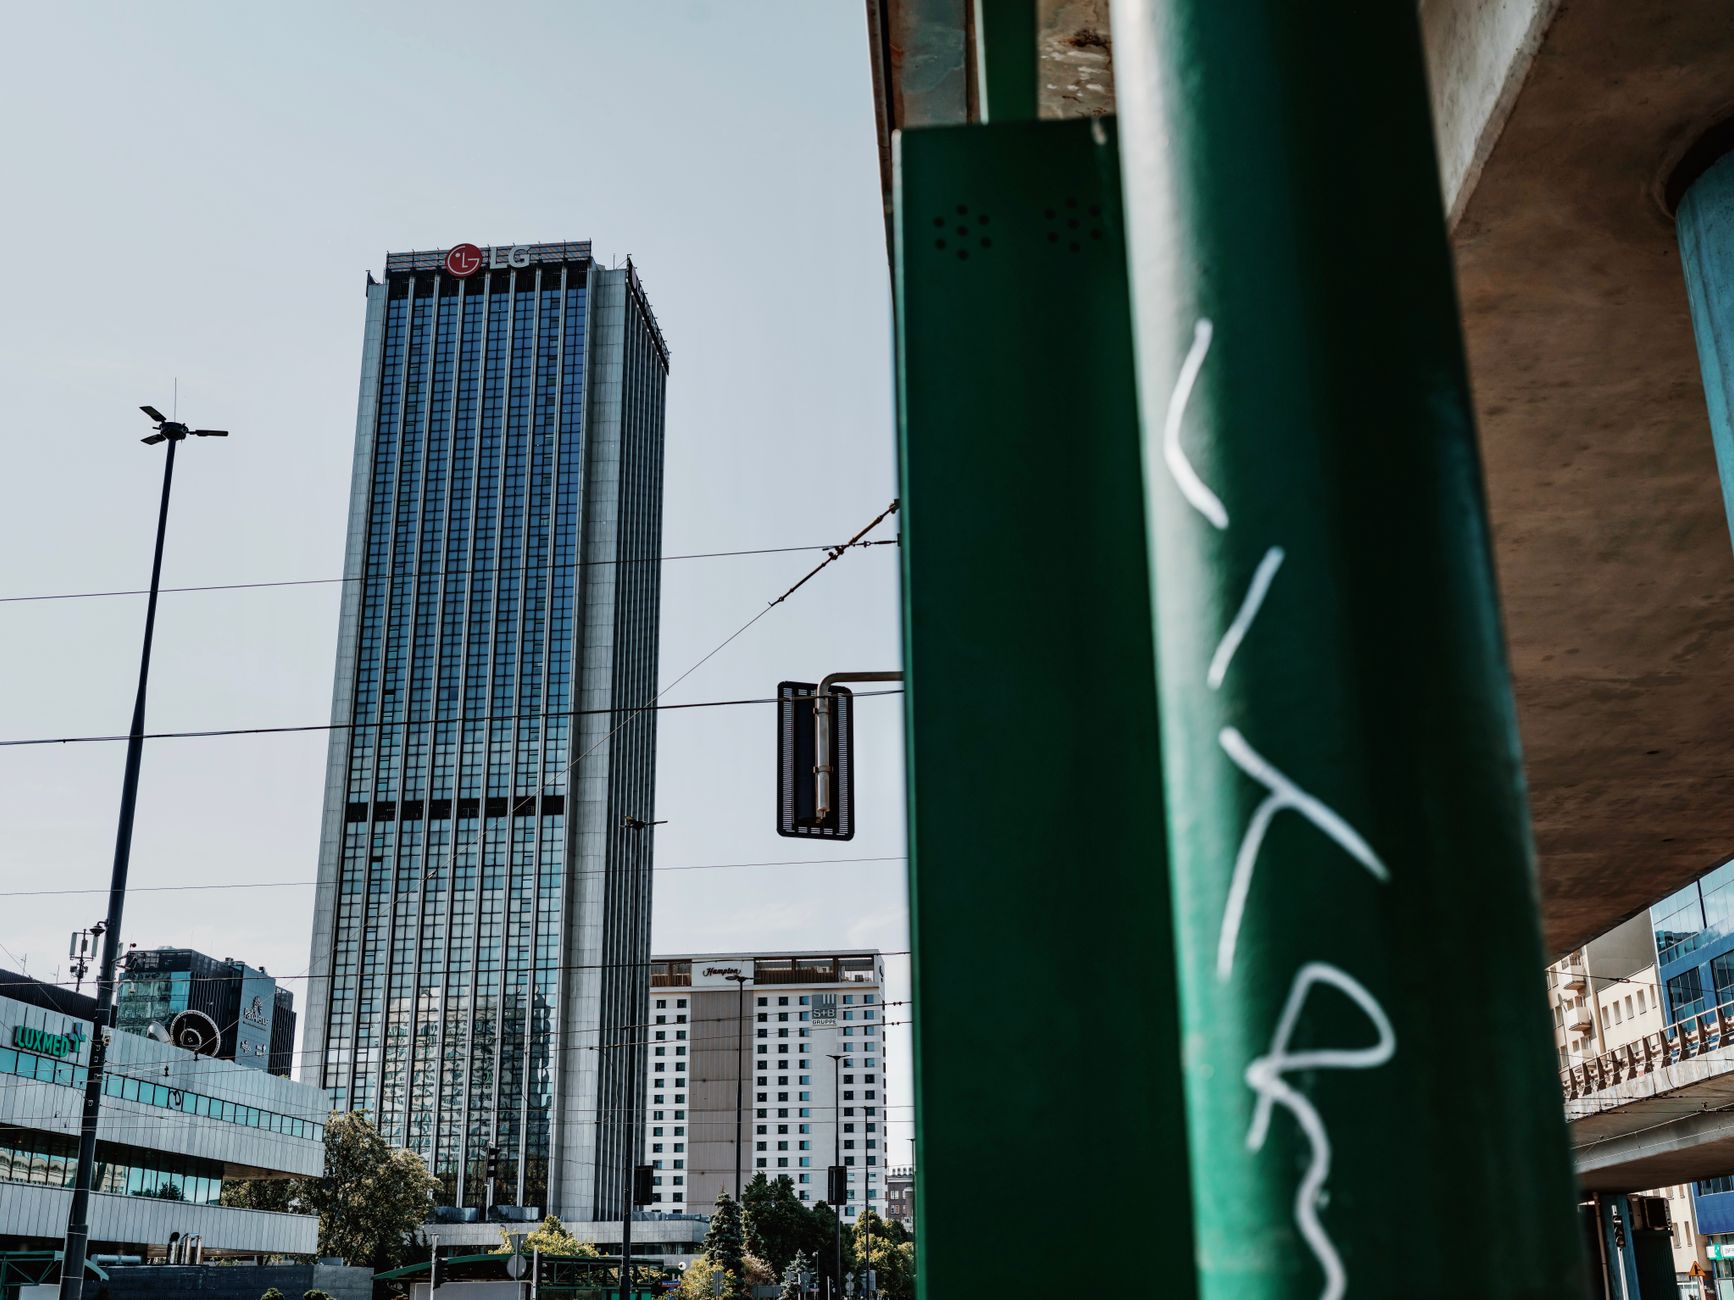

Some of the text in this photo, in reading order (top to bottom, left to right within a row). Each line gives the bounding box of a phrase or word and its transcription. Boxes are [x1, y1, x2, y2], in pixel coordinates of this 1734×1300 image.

[490, 246, 531, 269] LG
[703, 967, 741, 976] Hampton
[813, 1009, 835, 1017] S+B
[15, 1025, 69, 1057] LUXMED
